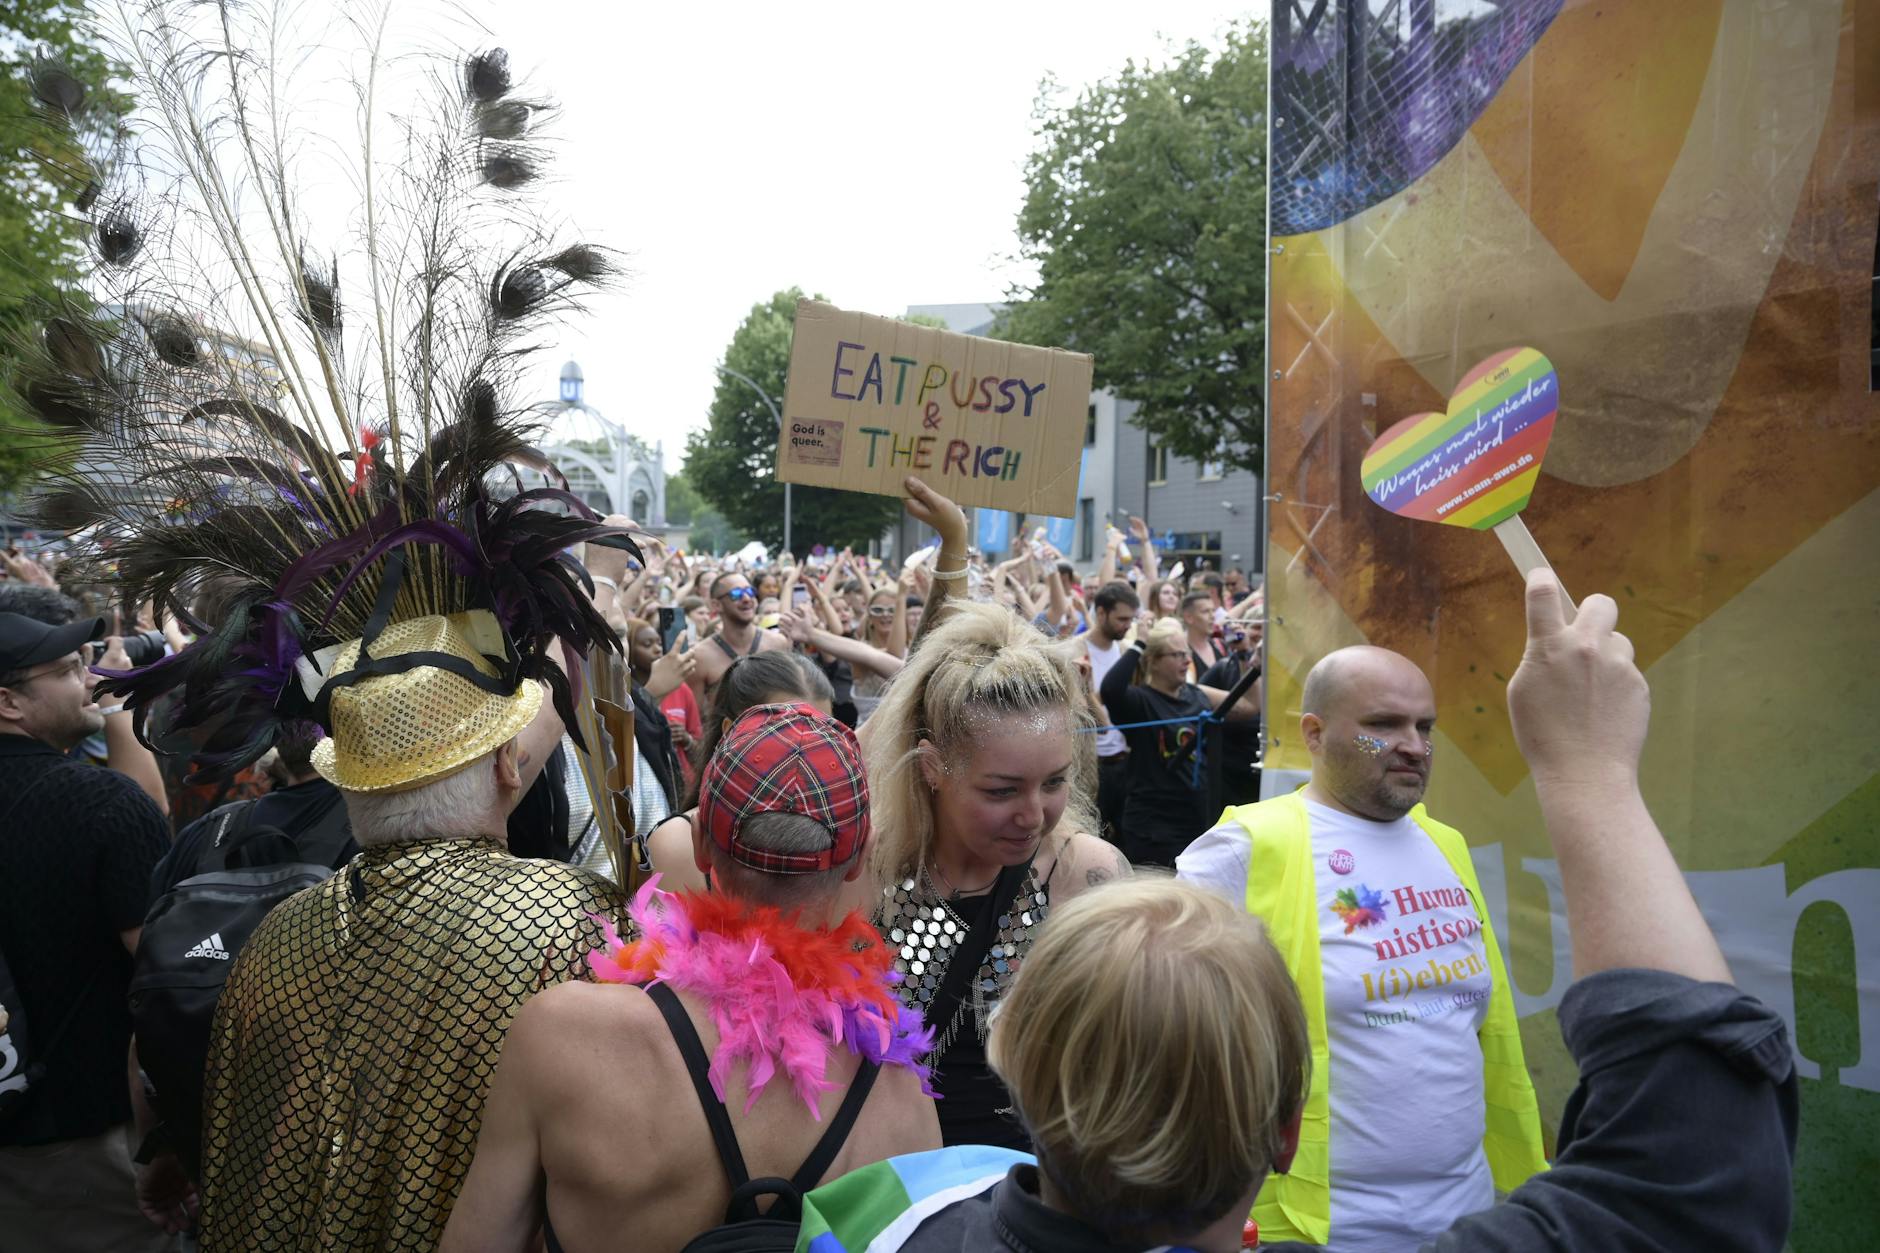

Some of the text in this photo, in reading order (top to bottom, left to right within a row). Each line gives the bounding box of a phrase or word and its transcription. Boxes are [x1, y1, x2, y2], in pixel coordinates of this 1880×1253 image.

[831, 341, 1046, 416] EAT PUSSY
[792, 424, 825, 436] God is
[923, 401, 943, 431] &
[1446, 409, 1488, 455] mal
[1492, 378, 1551, 423] wieder
[791, 437, 824, 448] queer.
[859, 427, 1022, 481] THE RICH
[1416, 461, 1461, 497] heiss
[1464, 420, 1504, 465] wird
[1436, 453, 1533, 515] www.team-awo.de
[1391, 885, 1468, 917] Huma
[185, 948, 230, 960] adidas
[1364, 1007, 1416, 1029] bunt,
